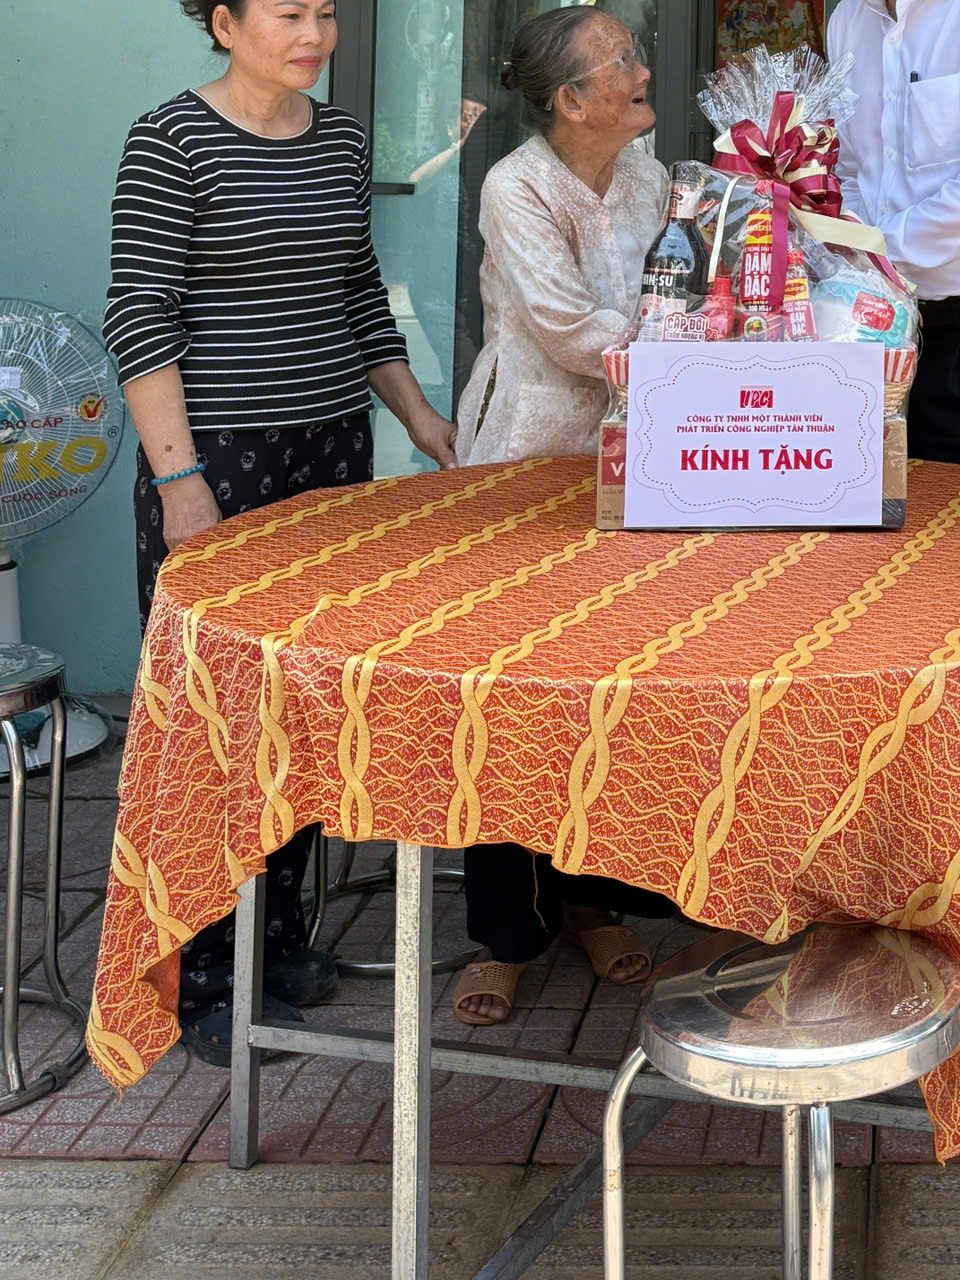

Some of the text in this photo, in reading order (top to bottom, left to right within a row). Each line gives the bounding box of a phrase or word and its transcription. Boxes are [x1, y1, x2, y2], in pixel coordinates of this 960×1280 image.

[744, 273, 770, 300] ĐẶC
[31, 416, 64, 429] CẤP
[686, 413, 823, 424] CÔNG TY TNHH MỘT THÀNH VIÊN
[676, 423, 835, 434] PHÁT TRIỂN CÔNG NGHIỆP TÂN THUẬN
[680, 444, 833, 475] KÍNH TẶNG
